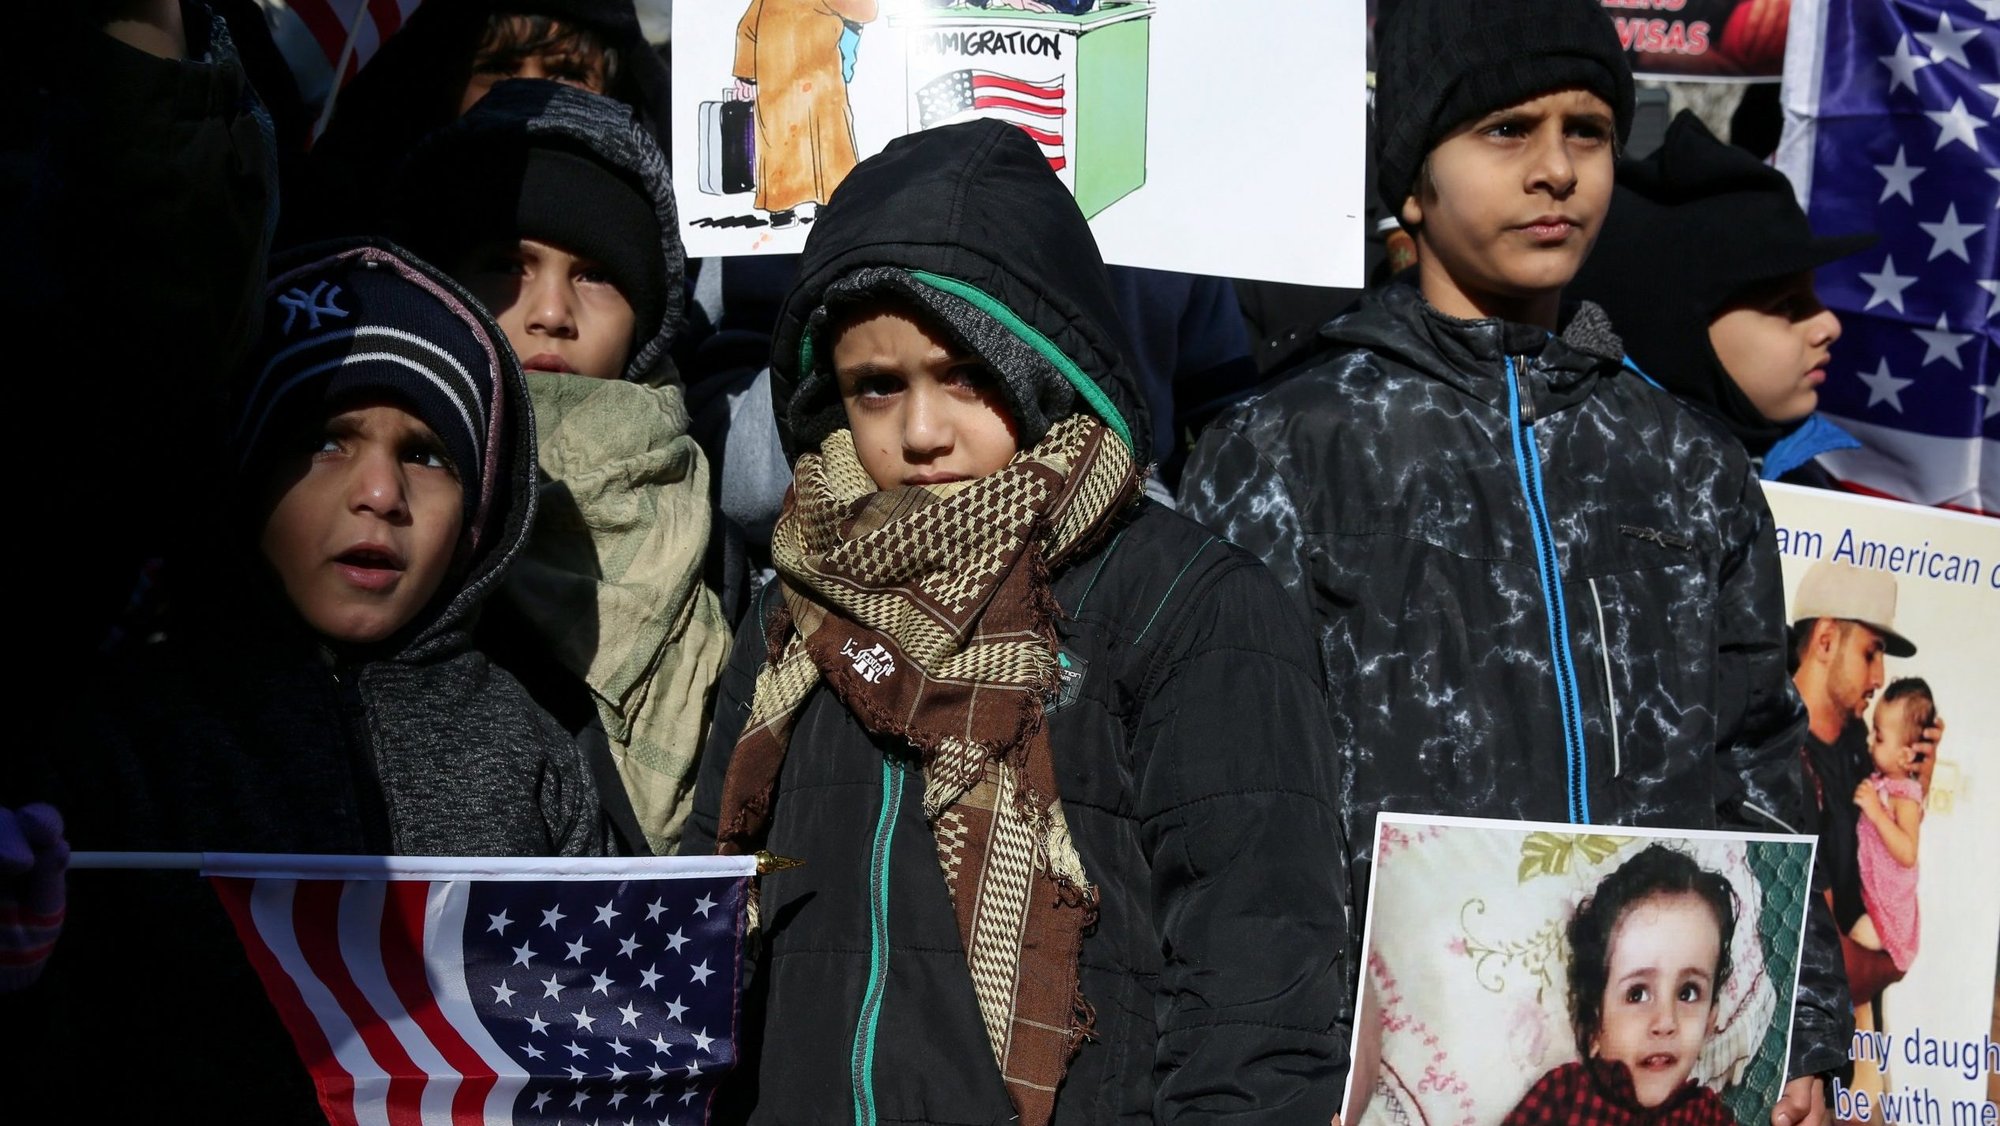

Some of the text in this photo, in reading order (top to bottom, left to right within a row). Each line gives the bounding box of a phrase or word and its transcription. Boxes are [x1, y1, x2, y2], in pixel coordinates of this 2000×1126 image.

[917, 30, 1062, 60] MMIGRATION
[1614, 17, 1711, 54] VISAS
[1775, 527, 1823, 559] am
[1833, 528, 1980, 585] American
[1850, 1027, 2000, 1080] my daugh
[1834, 1078, 1997, 1126] be with me
